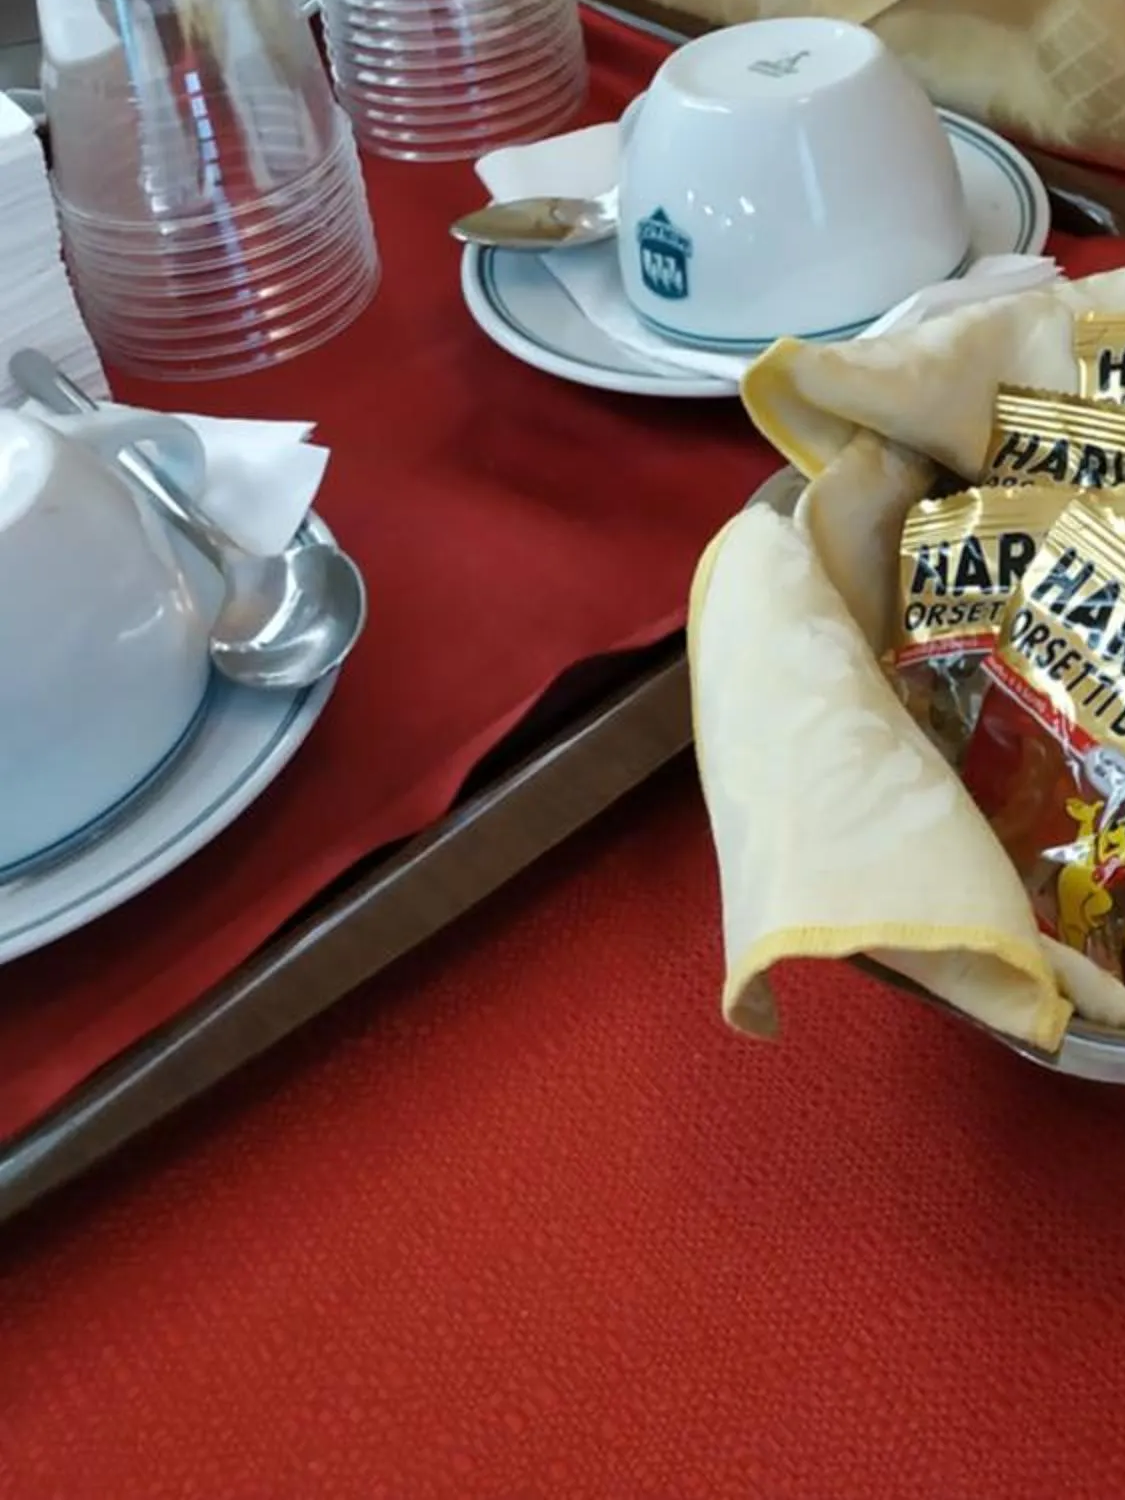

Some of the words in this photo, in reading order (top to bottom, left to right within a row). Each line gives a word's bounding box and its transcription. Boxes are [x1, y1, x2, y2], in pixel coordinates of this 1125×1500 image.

[911, 532, 1036, 597] HAR
[904, 600, 1007, 632] ORSET
[1009, 608, 1122, 718] ORSETTI
